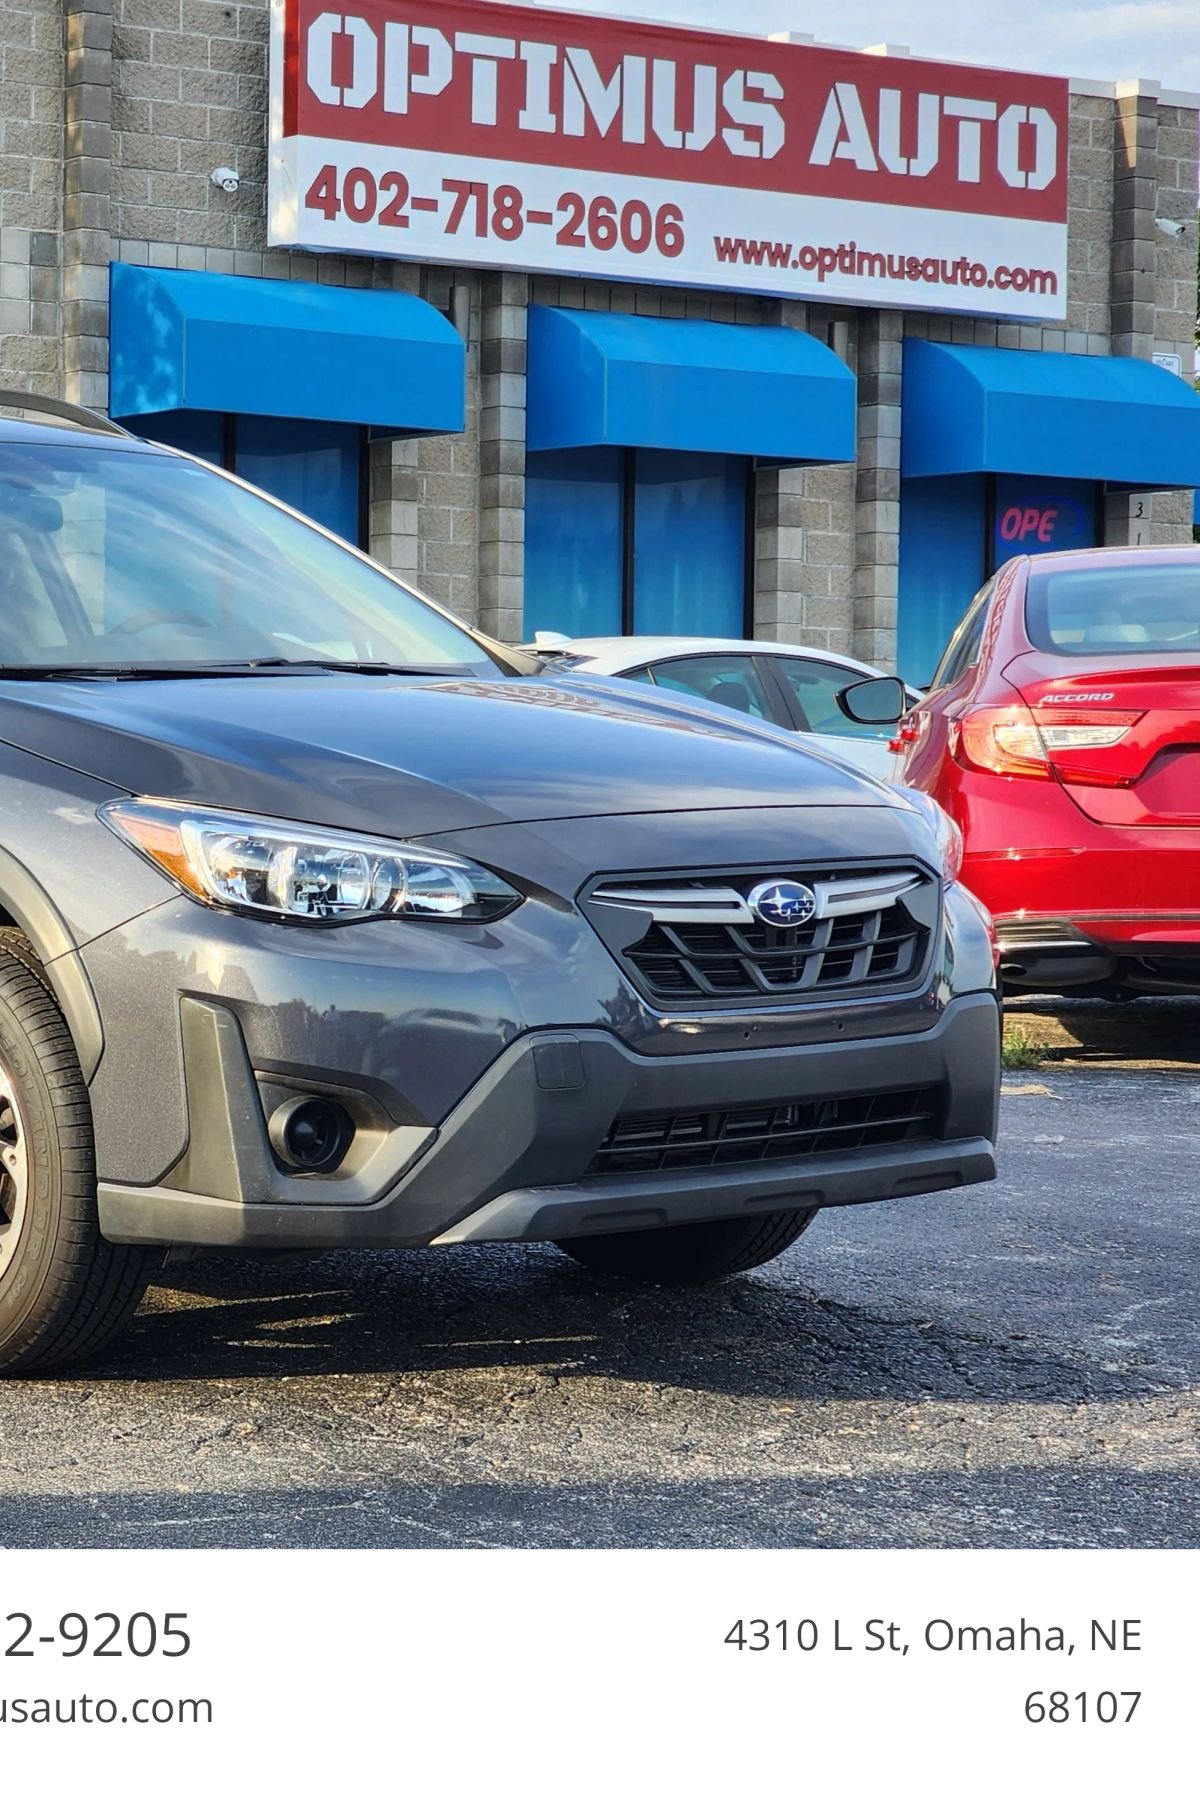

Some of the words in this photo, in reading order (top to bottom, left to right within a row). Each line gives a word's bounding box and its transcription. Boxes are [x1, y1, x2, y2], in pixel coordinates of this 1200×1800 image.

[306, 12, 785, 160] OPTIMUS
[808, 82, 1057, 191] AUTO
[304, 165, 685, 258] 402-718-2606
[714, 236, 1058, 295] www.optimusauto.com
[1040, 692, 1115, 703] ACCORD
